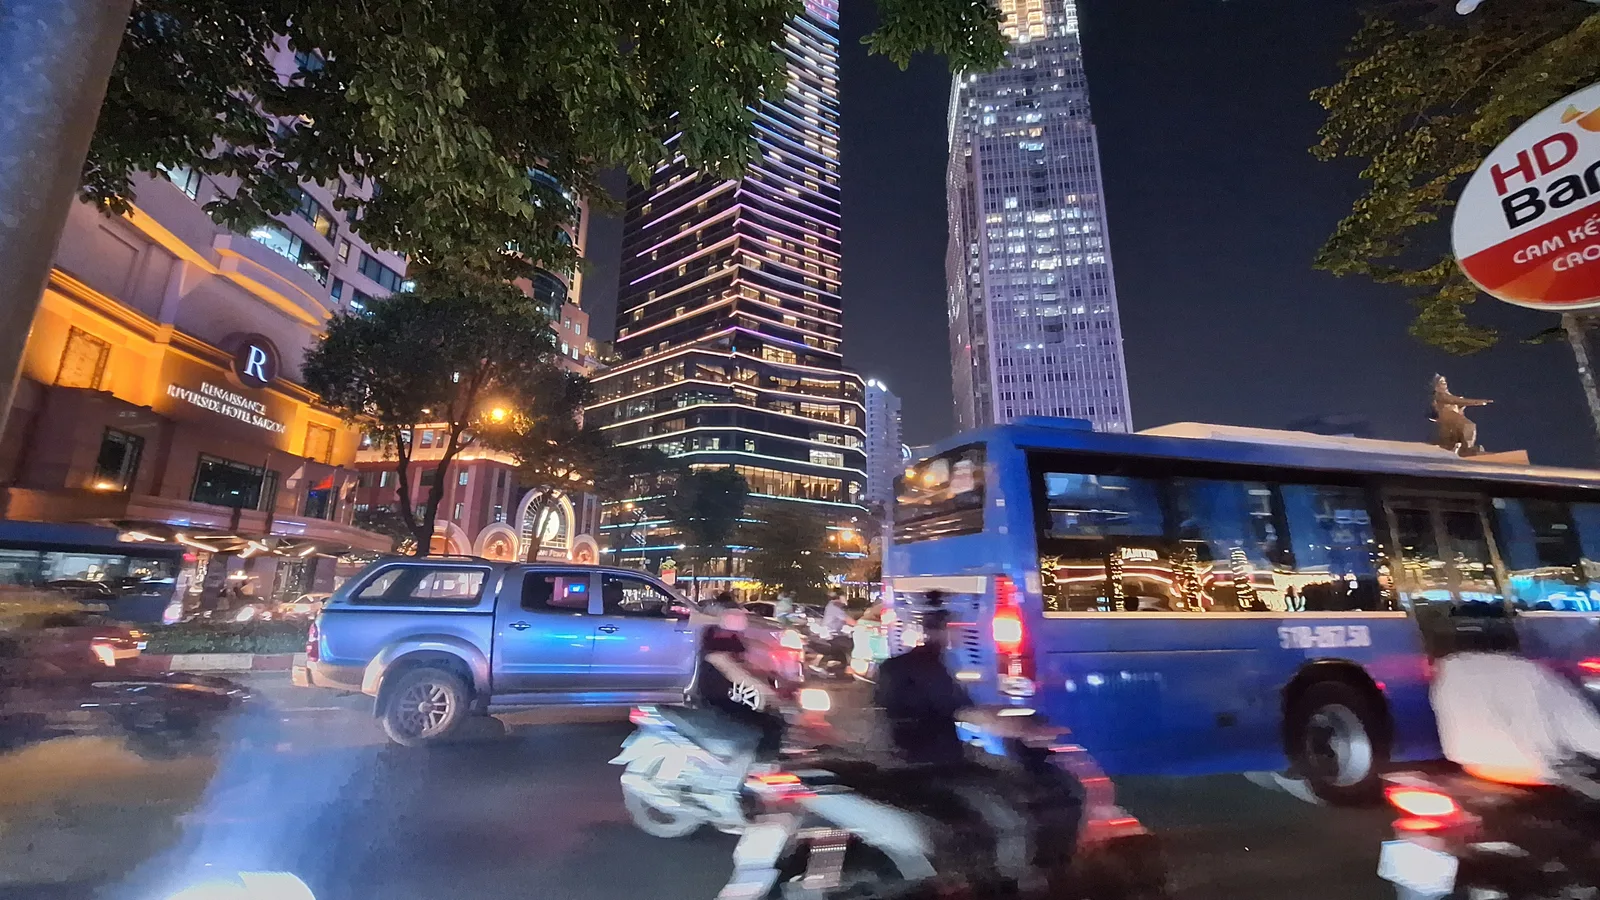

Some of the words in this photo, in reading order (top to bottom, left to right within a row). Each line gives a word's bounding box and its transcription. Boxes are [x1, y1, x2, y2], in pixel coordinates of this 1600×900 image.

[1490, 132, 1579, 196] HD
[1512, 235, 1565, 264] CAM
[1567, 213, 1600, 243] KẾ
[1552, 244, 1600, 272] CAO
[243, 345, 269, 383] R
[166, 384, 220, 413] RIVERSIDE
[221, 404, 251, 424] HOTEL
[200, 381, 267, 415] RENAISSANCE
